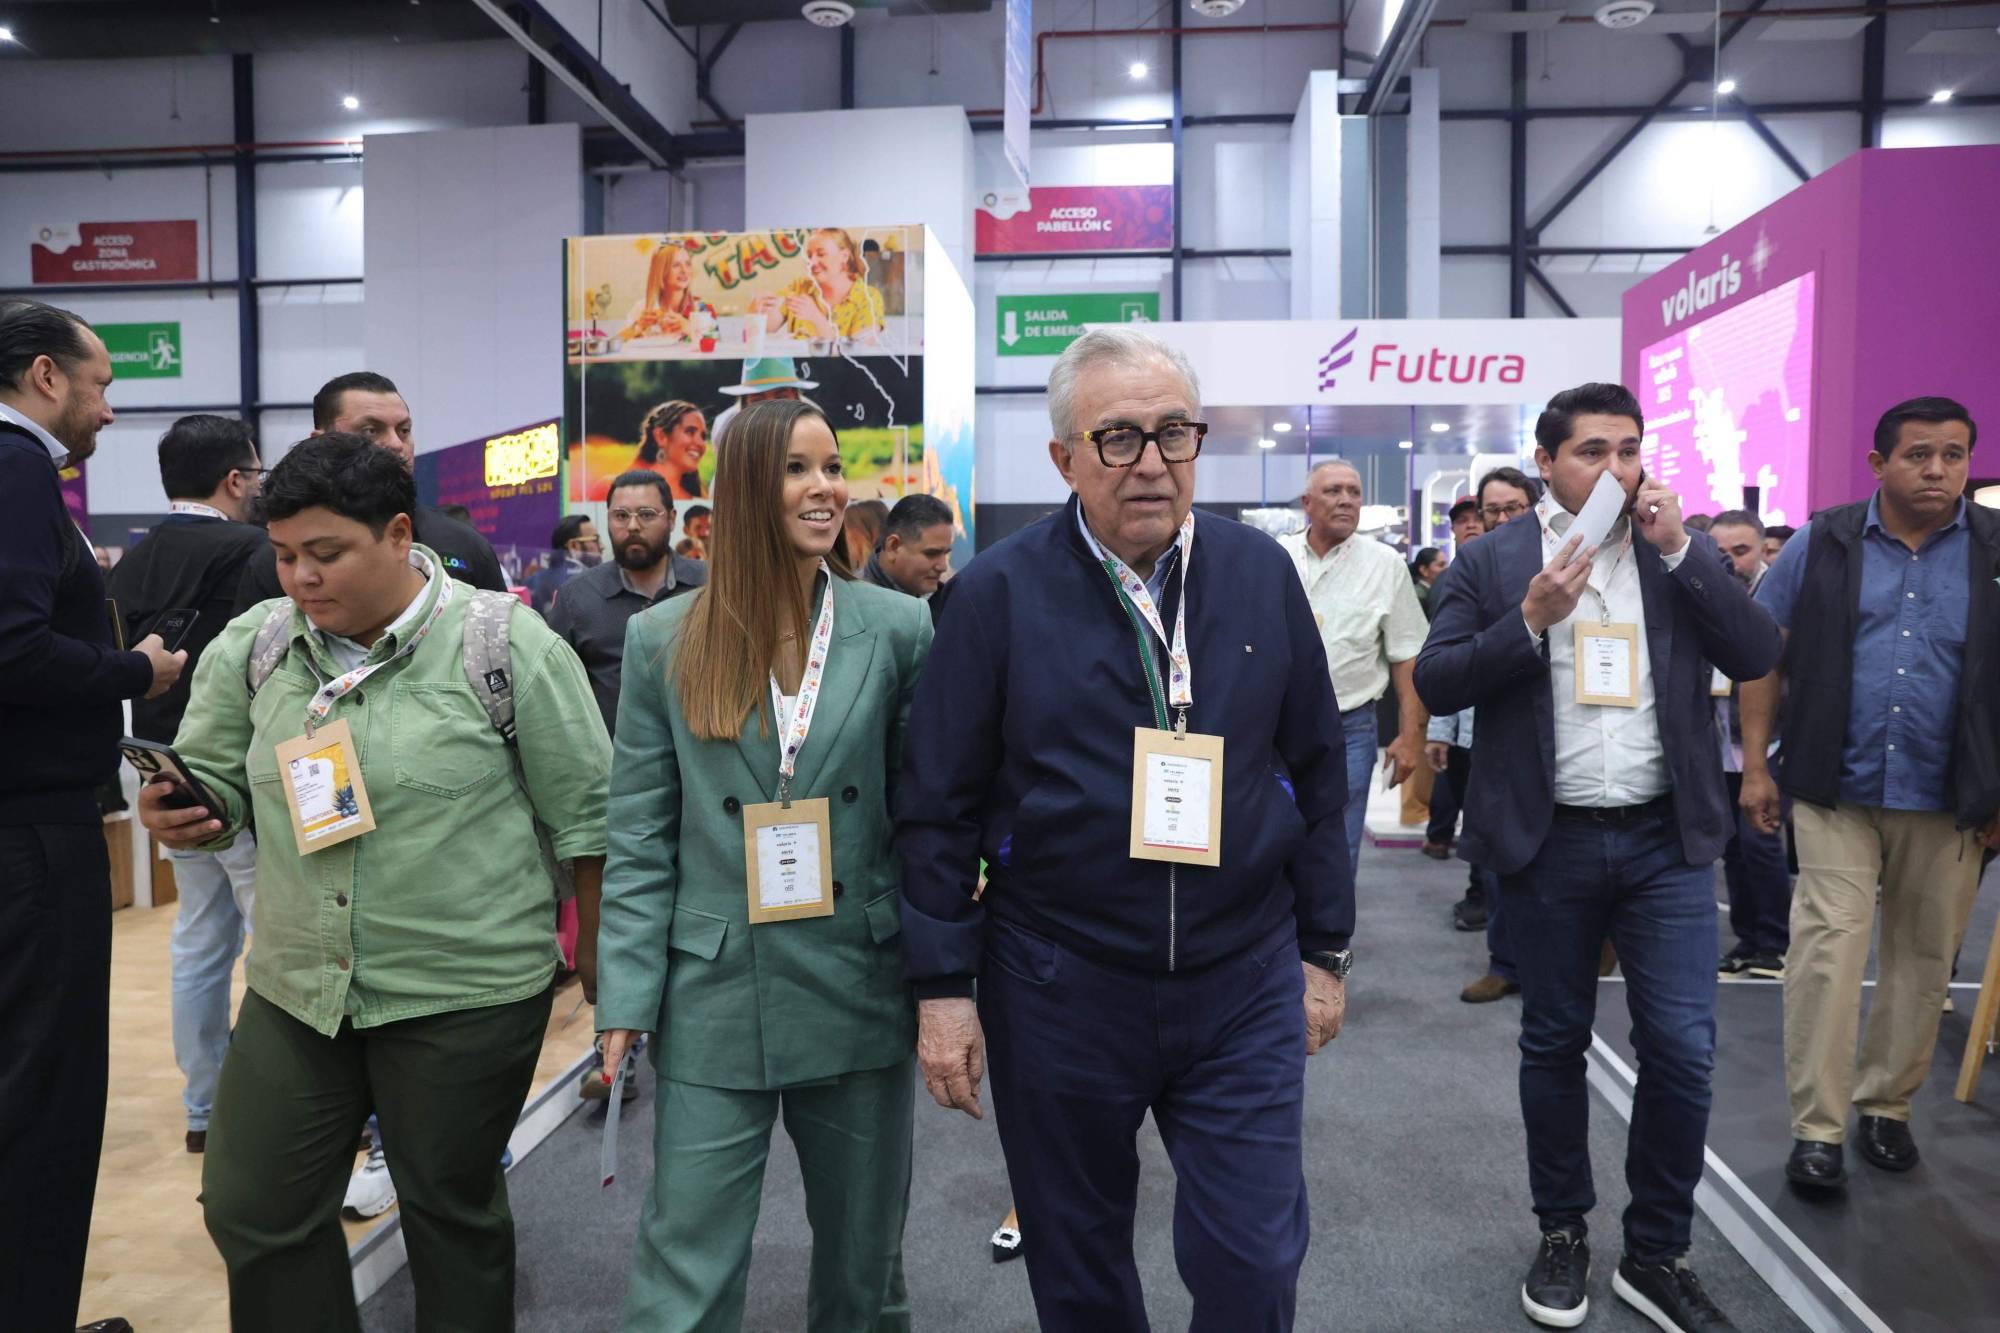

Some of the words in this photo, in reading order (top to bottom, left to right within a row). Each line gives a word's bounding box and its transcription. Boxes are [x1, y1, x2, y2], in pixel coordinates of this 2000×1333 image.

[1050, 207, 1098, 219] ACCESO
[1036, 219, 1101, 232] PABELLÓN
[1103, 220, 1112, 231] C
[94, 236, 132, 245] ACCESO
[99, 248, 128, 258] ZONA
[704, 229, 812, 289] TAC
[73, 260, 156, 271] GASTRONÓMICA
[1661, 253, 1742, 327] volaris
[1024, 310, 1068, 321] SALIDA
[1024, 326, 1041, 337] DE
[1043, 325, 1087, 336] EMERG
[110, 352, 150, 362] GENCIA
[1369, 344, 1524, 384] Futura
